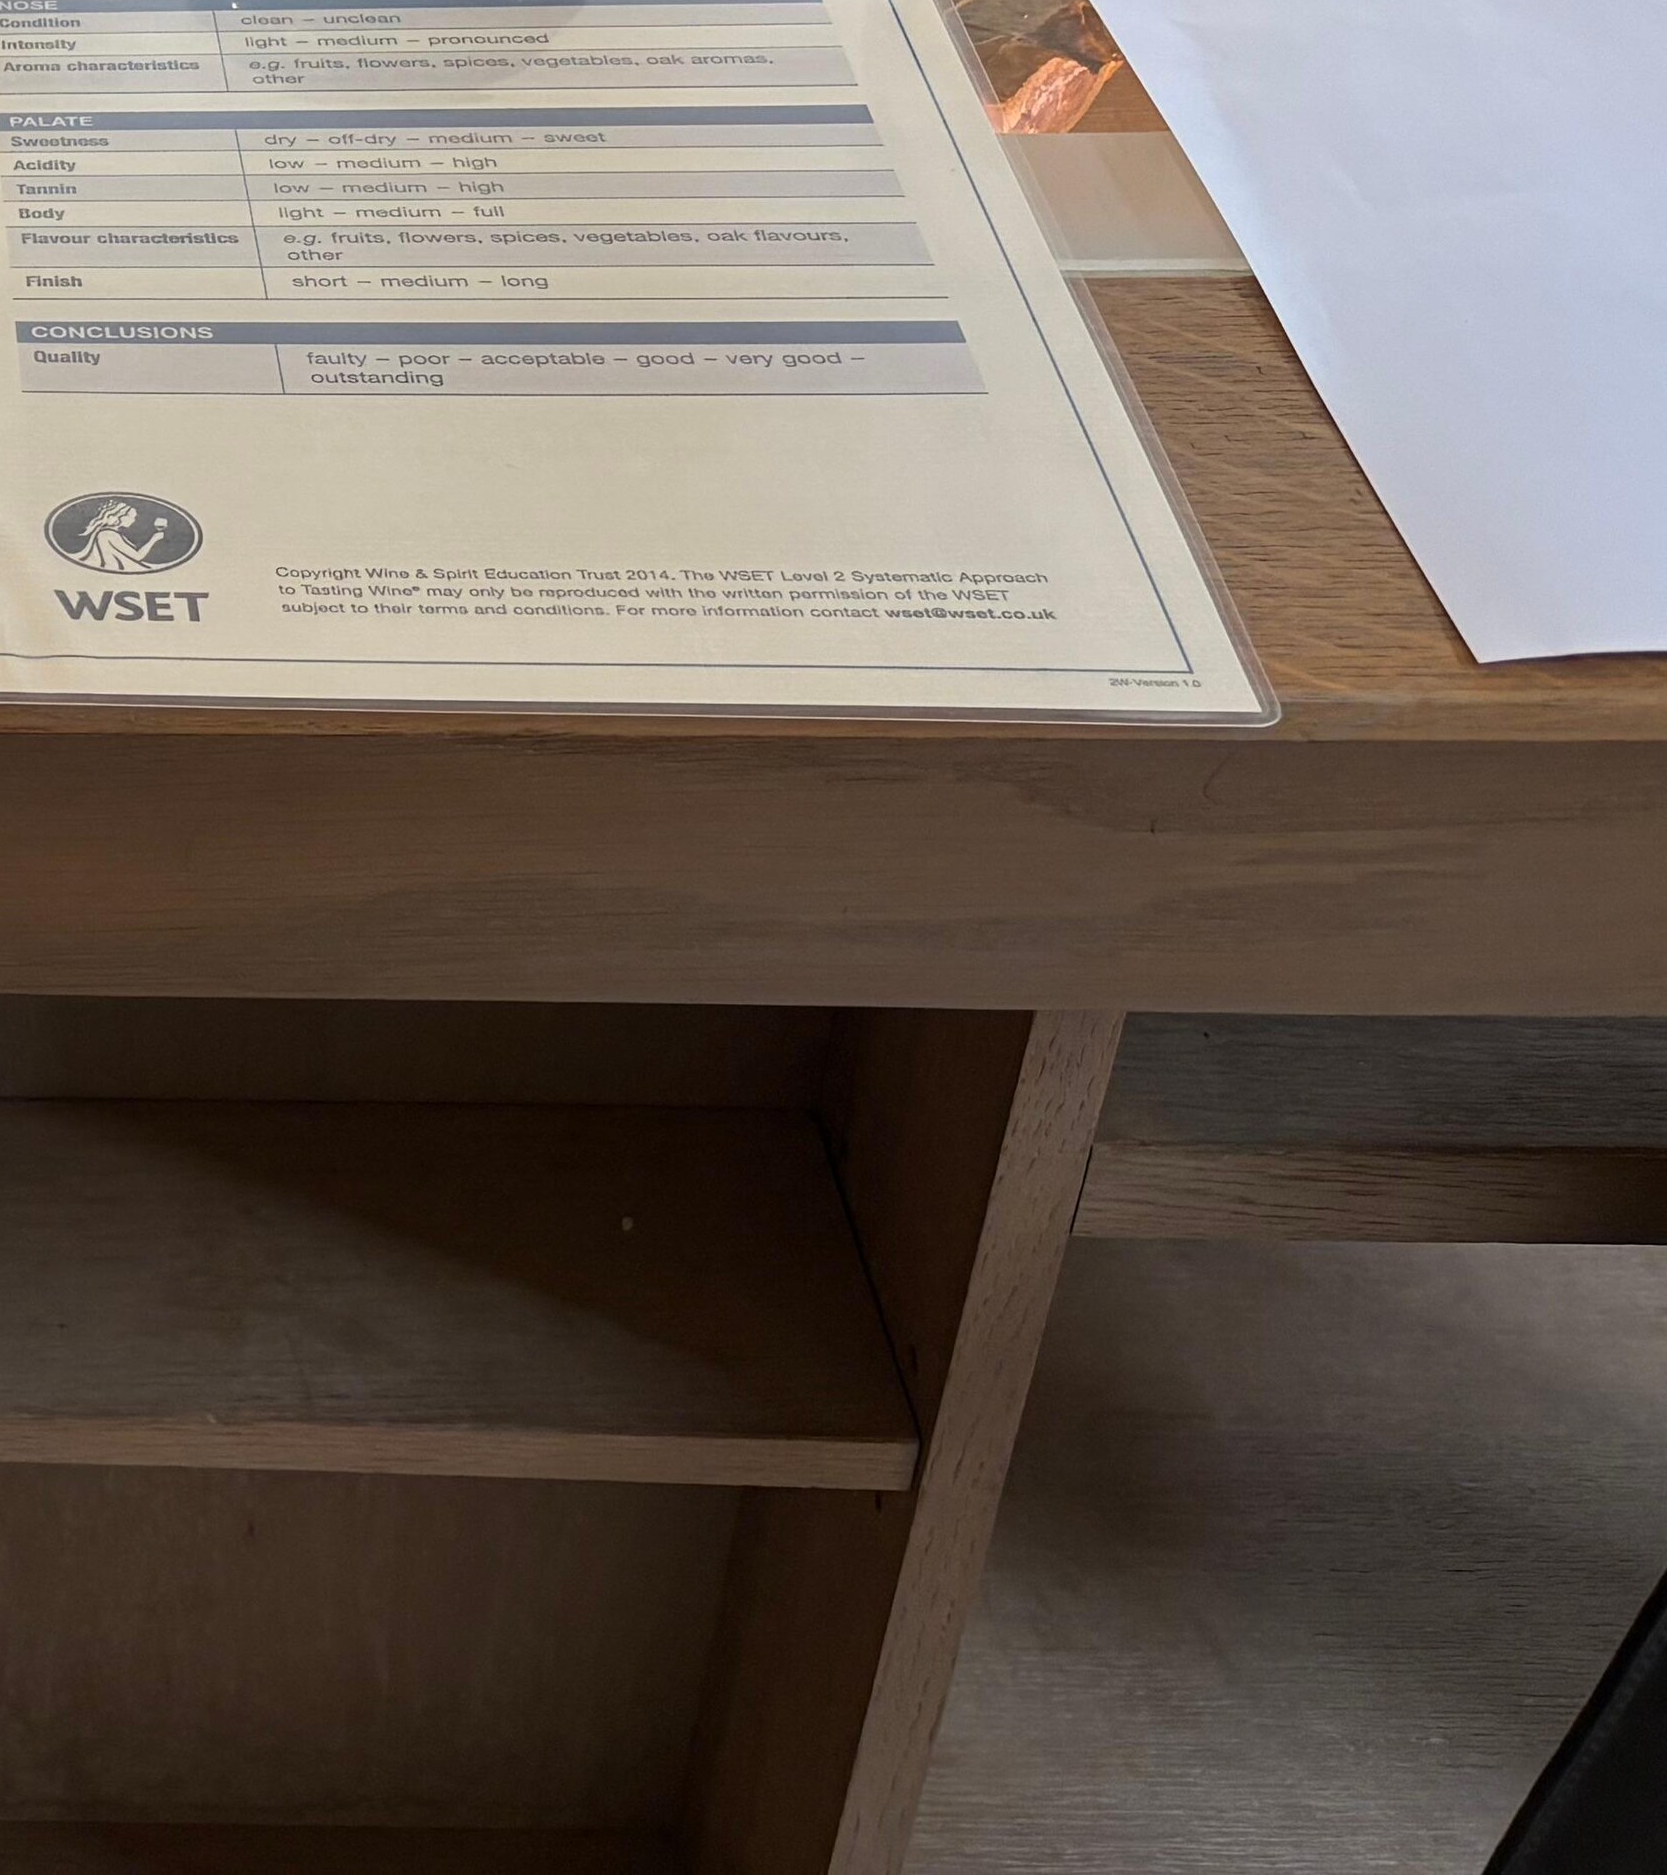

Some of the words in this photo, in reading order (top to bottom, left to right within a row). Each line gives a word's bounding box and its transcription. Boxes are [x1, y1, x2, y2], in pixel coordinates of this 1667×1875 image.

[0, 16, 81, 29] Condition
[241, 13, 295, 26] clean
[323, 12, 401, 24] unclean
[1, 37, 76, 53] Intensity
[245, 35, 288, 50] light
[316, 34, 398, 47] medium
[428, 31, 549, 49] pronounced
[3, 61, 57, 73] Aroma
[63, 59, 199, 73] characteristics
[249, 59, 286, 74] e.g.
[294, 57, 351, 72] fruits,
[358, 57, 437, 70] flowers,
[443, 56, 515, 71] spices,
[522, 54, 640, 70] vegetables,
[646, 54, 684, 66] oak
[691, 54, 773, 67] aromas,
[252, 73, 305, 85] other
[9, 116, 93, 128] PALATE
[11, 134, 108, 147] Sweetness
[265, 133, 296, 148] dry
[329, 132, 396, 147] off-dry
[428, 131, 513, 145] medium
[544, 131, 606, 144] sweet
[13, 157, 76, 173] Acidity
[268, 156, 305, 170] low
[336, 156, 421, 169] medium
[451, 154, 497, 171] high
[16, 182, 77, 195] Tannin
[273, 181, 309, 194] low
[342, 181, 427, 194] medium
[458, 180, 504, 196] high
[19, 206, 65, 222] Body
[278, 205, 323, 221] light
[355, 205, 441, 219] medium
[473, 204, 505, 218] full
[21, 232, 91, 245] Flavour
[98, 231, 239, 245] characteristics
[283, 231, 323, 248] e.g.
[331, 230, 391, 246] fruits,
[397, 229, 483, 245] flowers,
[491, 229, 566, 246] spices,
[574, 227, 699, 245] vegetables,
[706, 227, 747, 242] oak
[755, 227, 849, 245] flavours,
[287, 247, 343, 261] other
[26, 274, 82, 287] Finish
[292, 274, 347, 287] short
[379, 274, 469, 287] medium
[501, 273, 548, 290] long
[31, 325, 213, 339] CONCLUSIONS
[34, 351, 100, 366] Quality
[307, 351, 366, 367] faulty
[399, 353, 449, 367] poor
[481, 351, 605, 366] acceptable
[637, 350, 695, 369] good
[726, 351, 773, 369] very
[783, 350, 842, 368] good
[311, 369, 444, 387] outstanding
[54, 591, 209, 623] WSET
